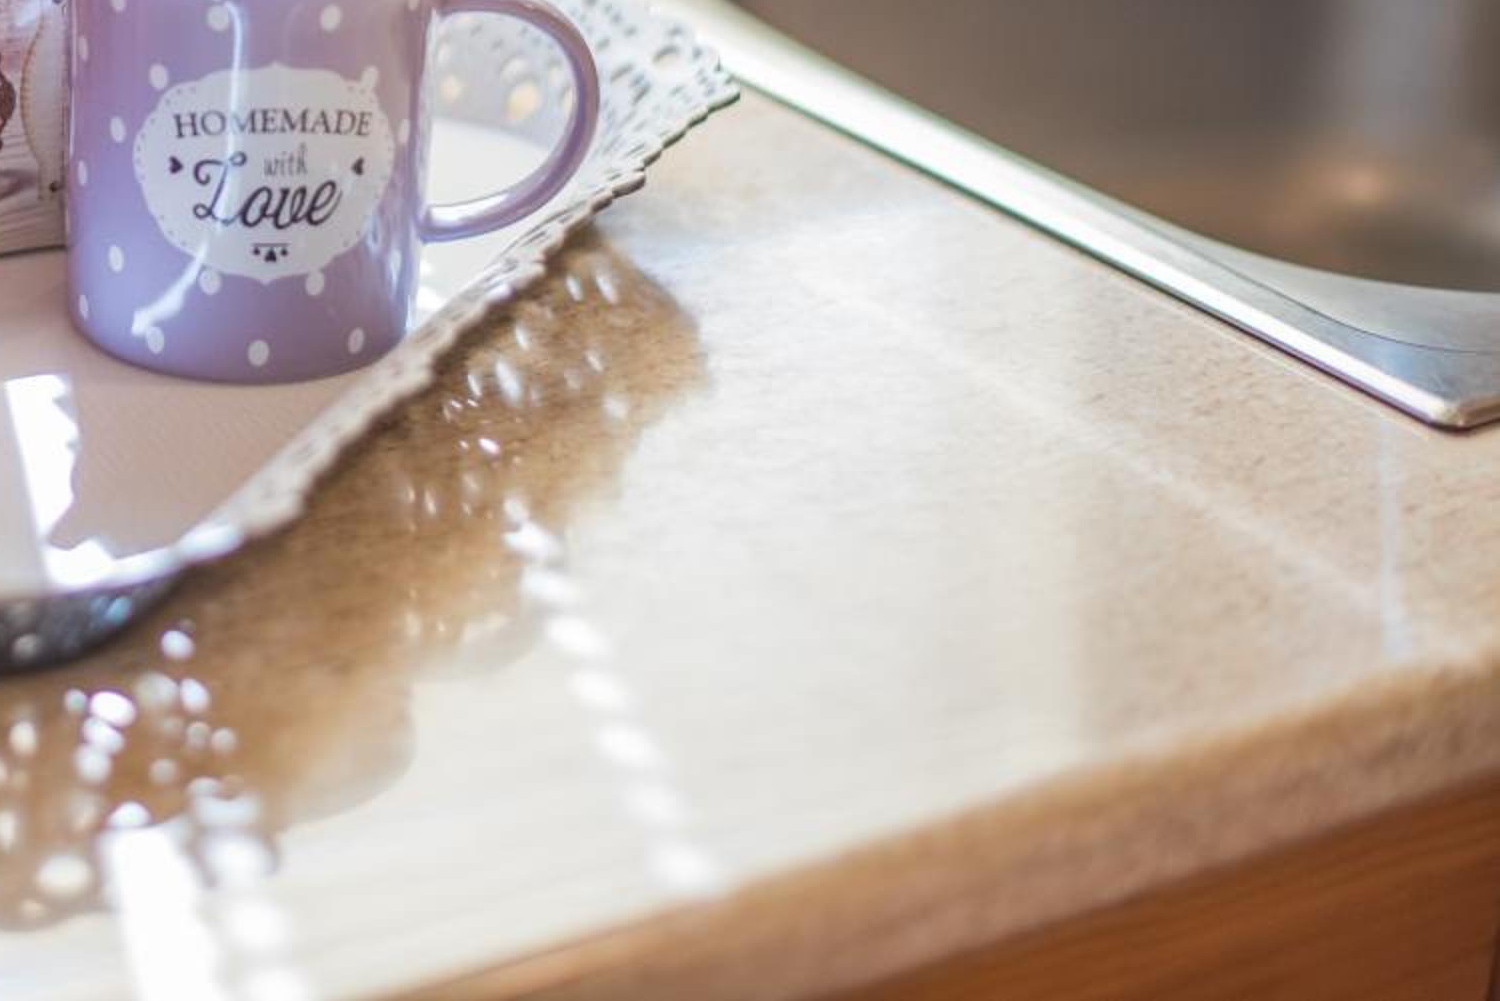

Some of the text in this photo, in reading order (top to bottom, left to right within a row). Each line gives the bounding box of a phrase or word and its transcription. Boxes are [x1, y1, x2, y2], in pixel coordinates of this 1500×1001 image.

[172, 108, 373, 138] HOMEMADE
[262, 142, 308, 177] with
[192, 151, 343, 230] Love
